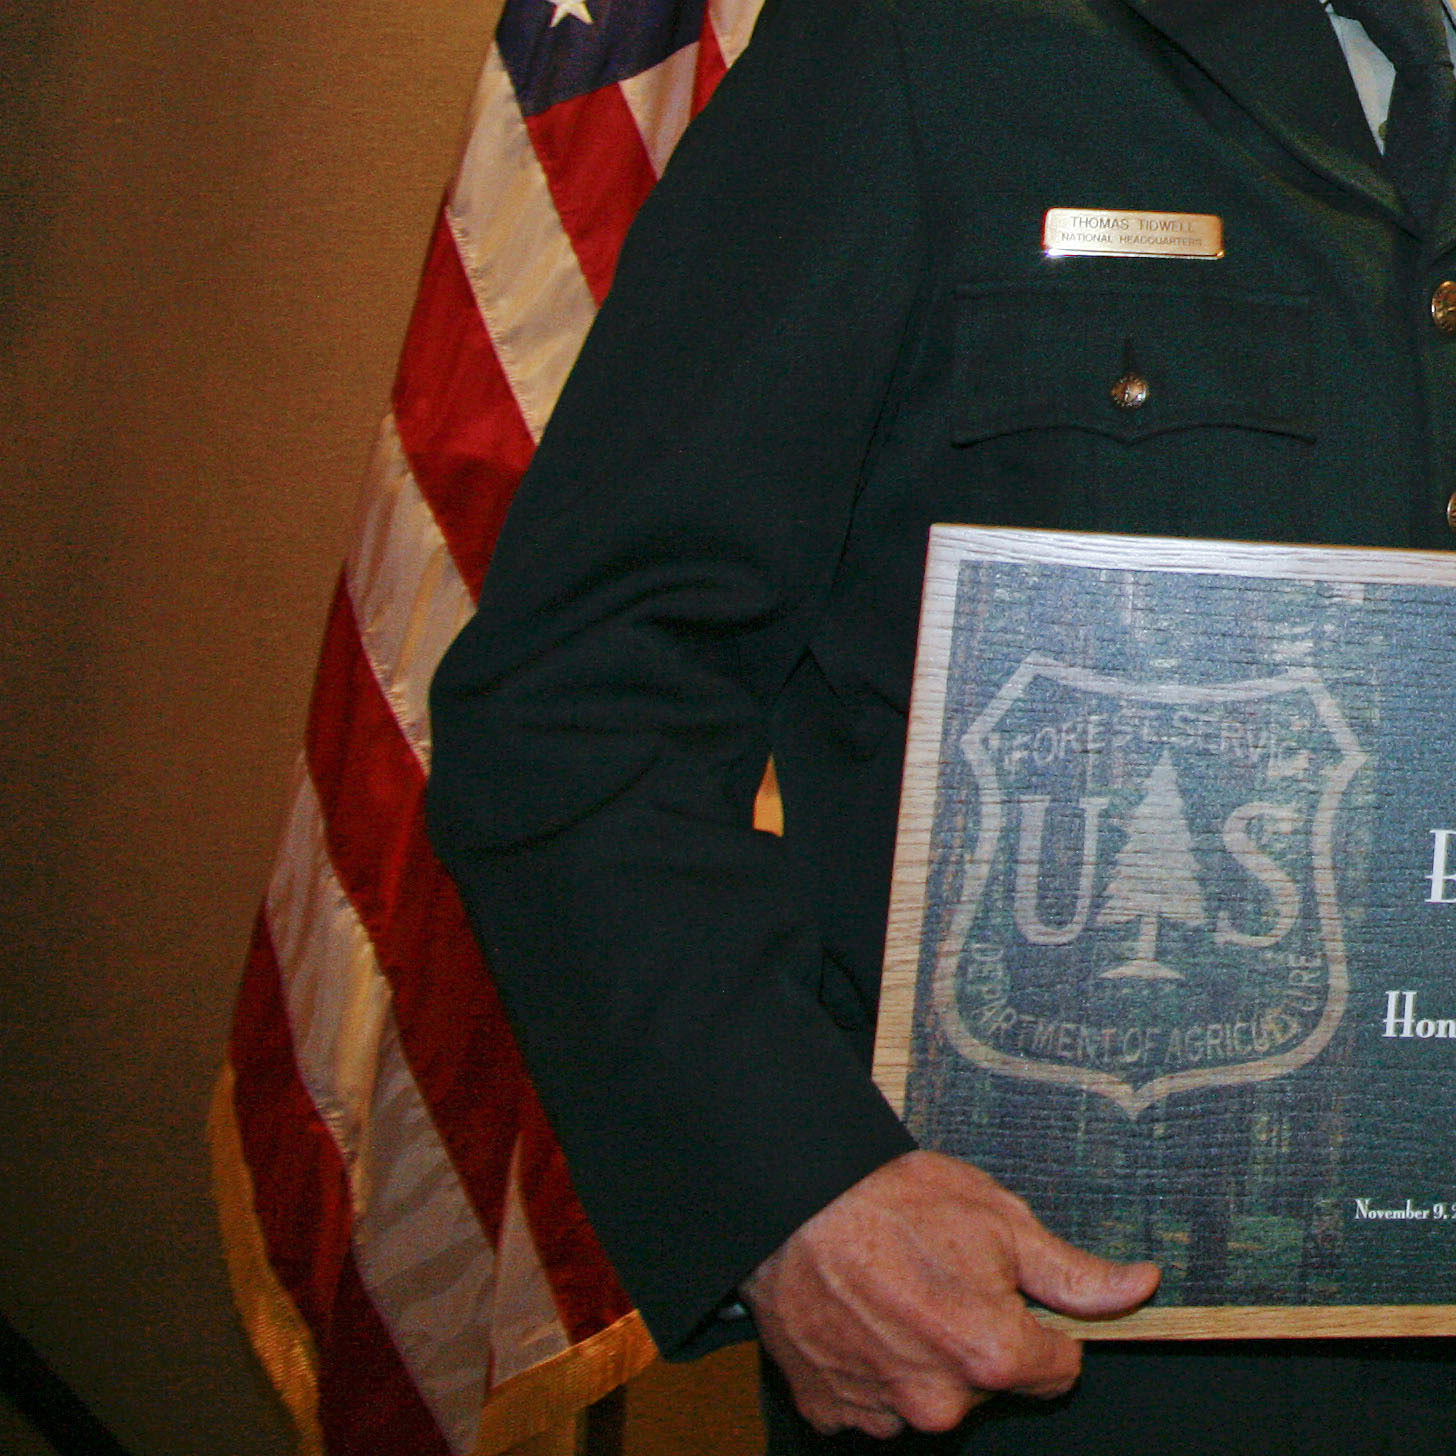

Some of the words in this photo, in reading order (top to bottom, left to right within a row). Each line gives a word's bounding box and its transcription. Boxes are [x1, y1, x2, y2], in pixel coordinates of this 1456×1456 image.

[1071, 215, 1129, 230] THOMAS
[1138, 219, 1195, 233] TIDWELL
[1061, 232, 1113, 244] NATIONAL
[1119, 236, 1202, 248] HEADQUARTERS
[1122, 1026, 1162, 1064] OF
[1354, 1198, 1430, 1220] November
